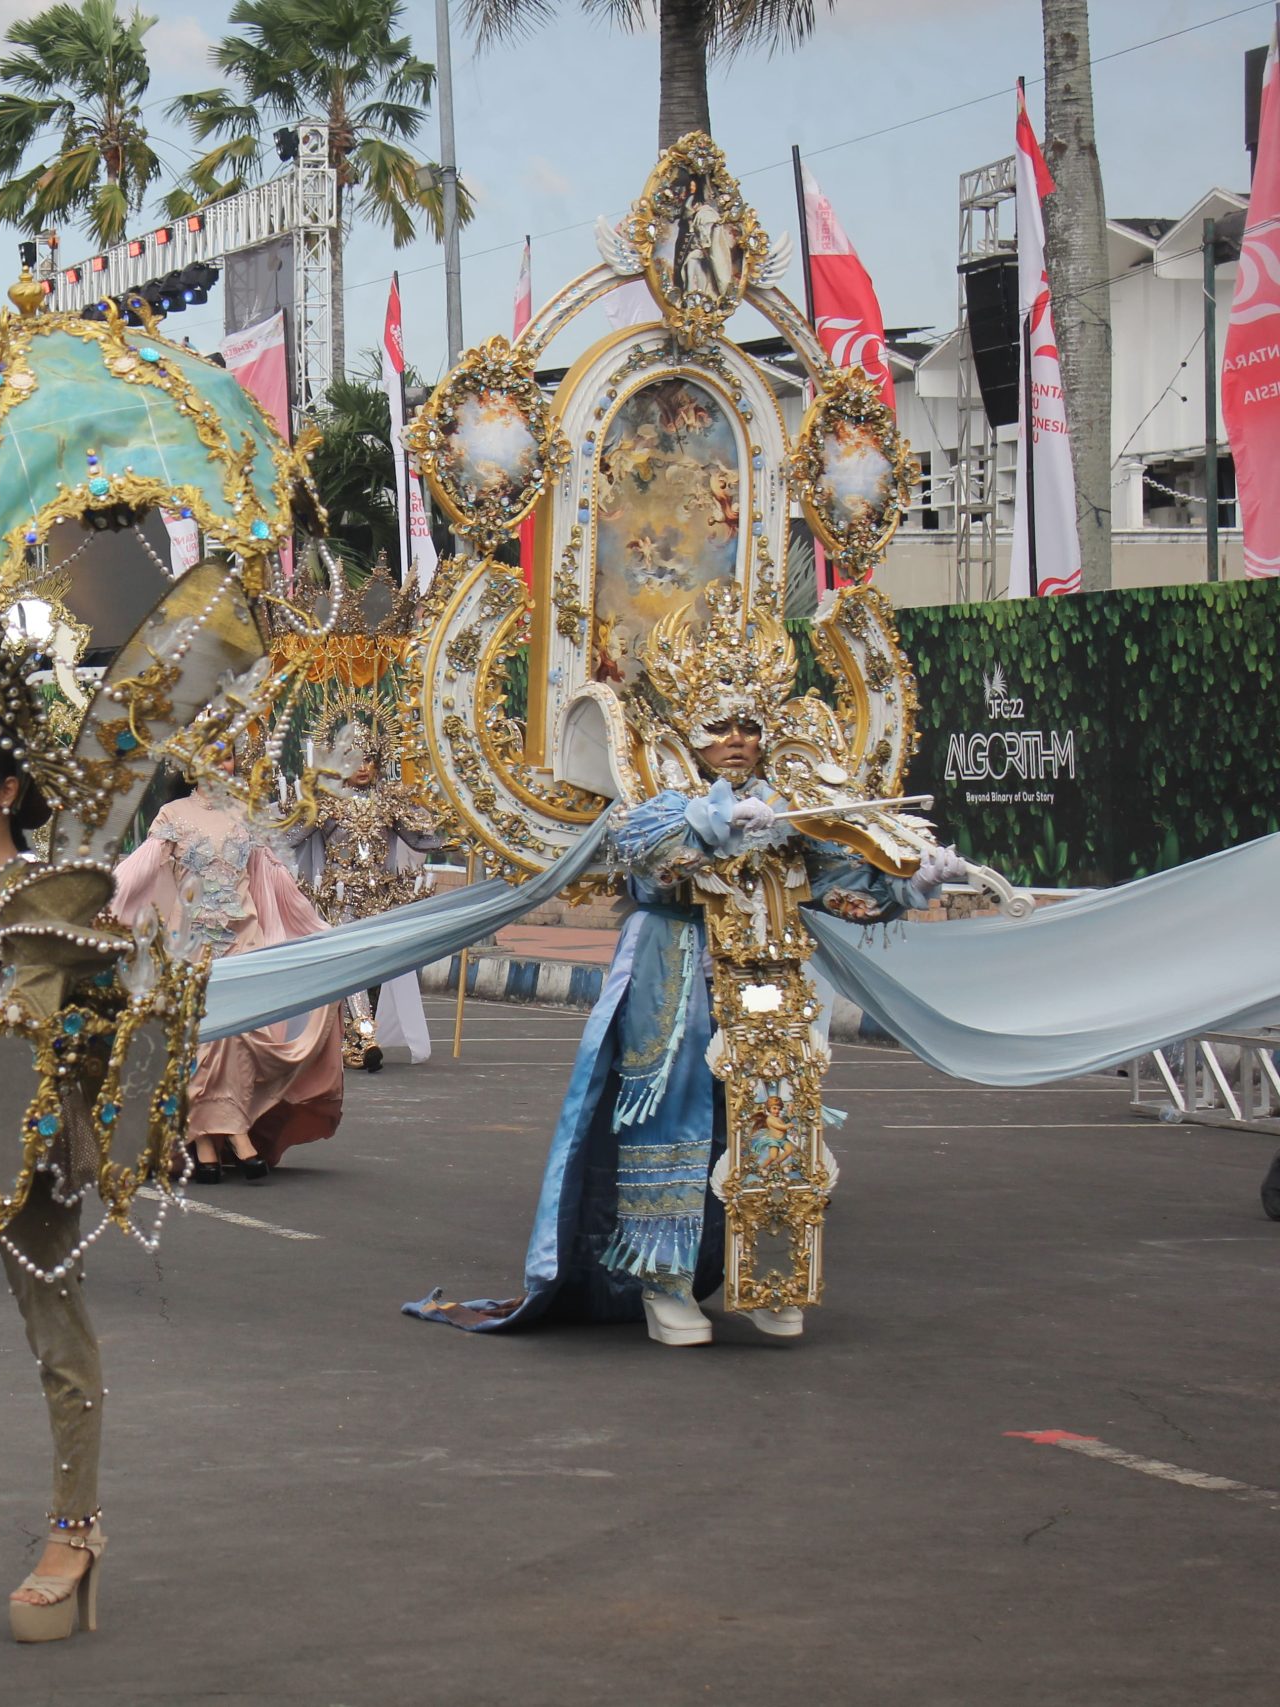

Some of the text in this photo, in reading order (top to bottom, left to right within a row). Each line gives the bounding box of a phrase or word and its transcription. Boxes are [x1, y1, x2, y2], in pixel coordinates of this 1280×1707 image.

[944, 730, 1075, 780] ALGORITHM
[966, 791, 1055, 805] Beyond Binary of Our Story
